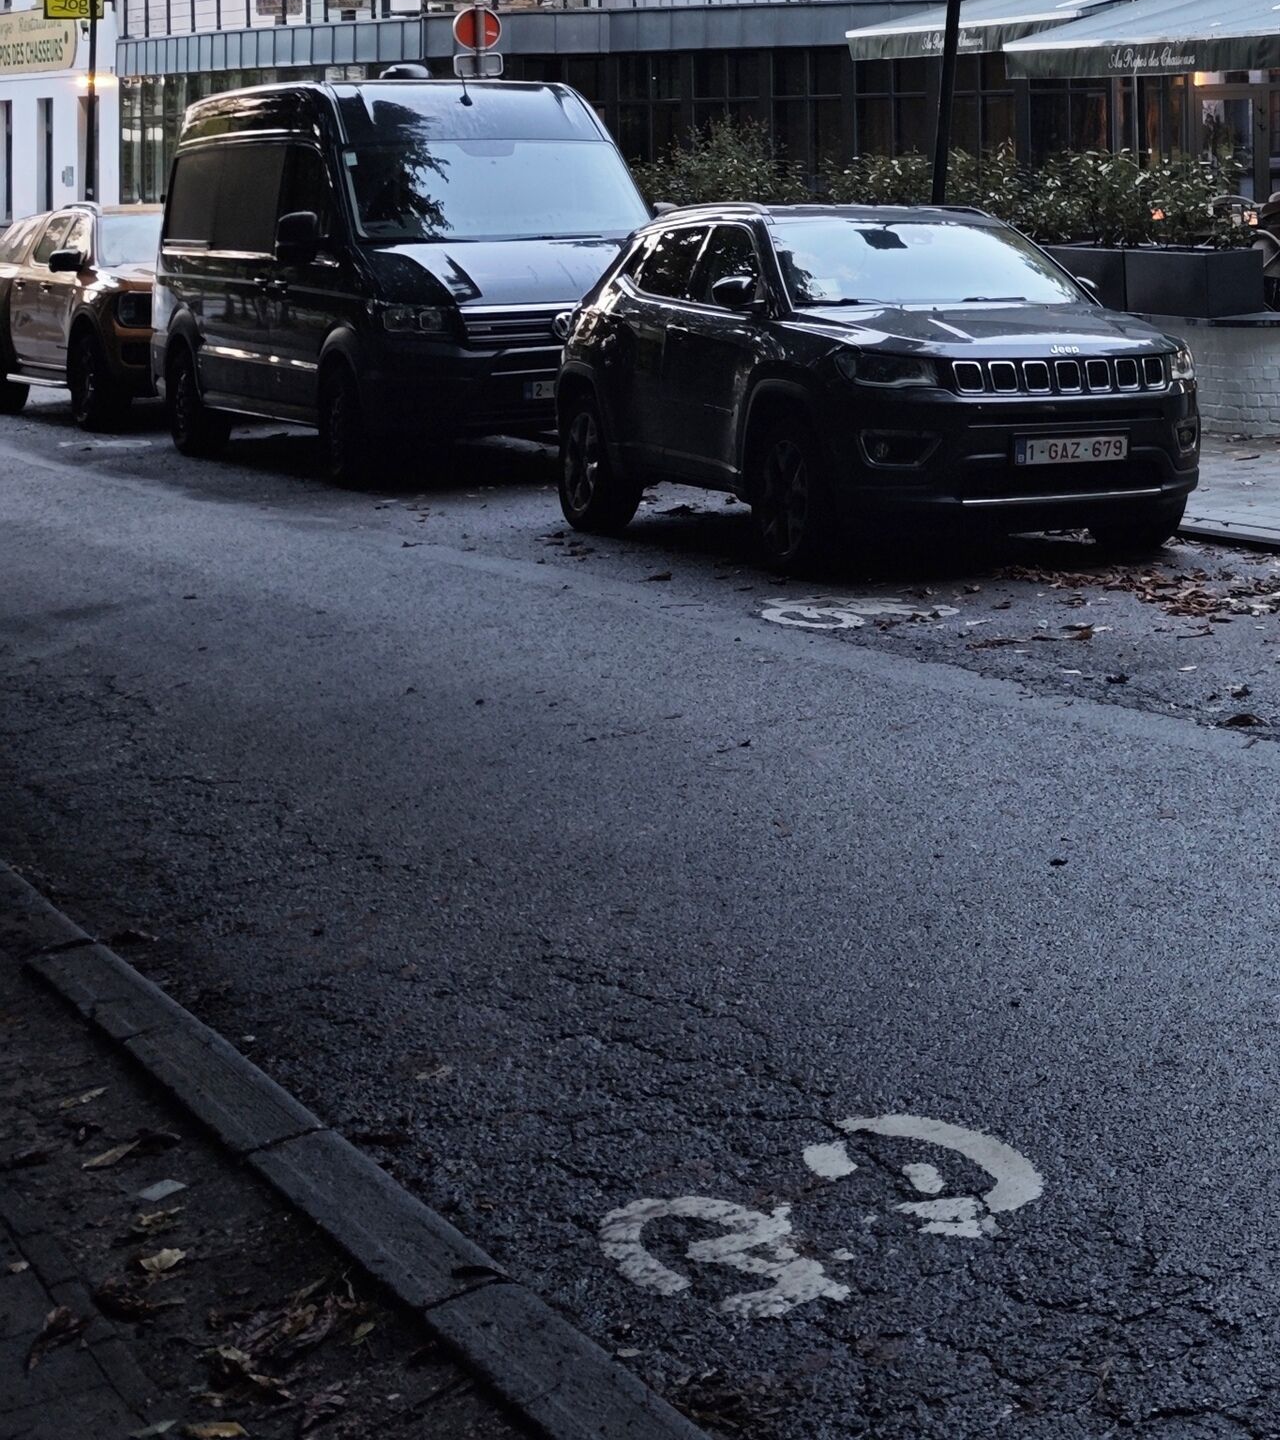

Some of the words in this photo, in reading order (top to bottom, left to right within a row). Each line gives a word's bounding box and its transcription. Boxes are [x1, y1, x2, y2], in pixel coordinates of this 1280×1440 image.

[12, 42, 24, 65] DES
[26, 38, 63, 64] CHASSEURS
[1050, 344, 1080, 354] Jeep
